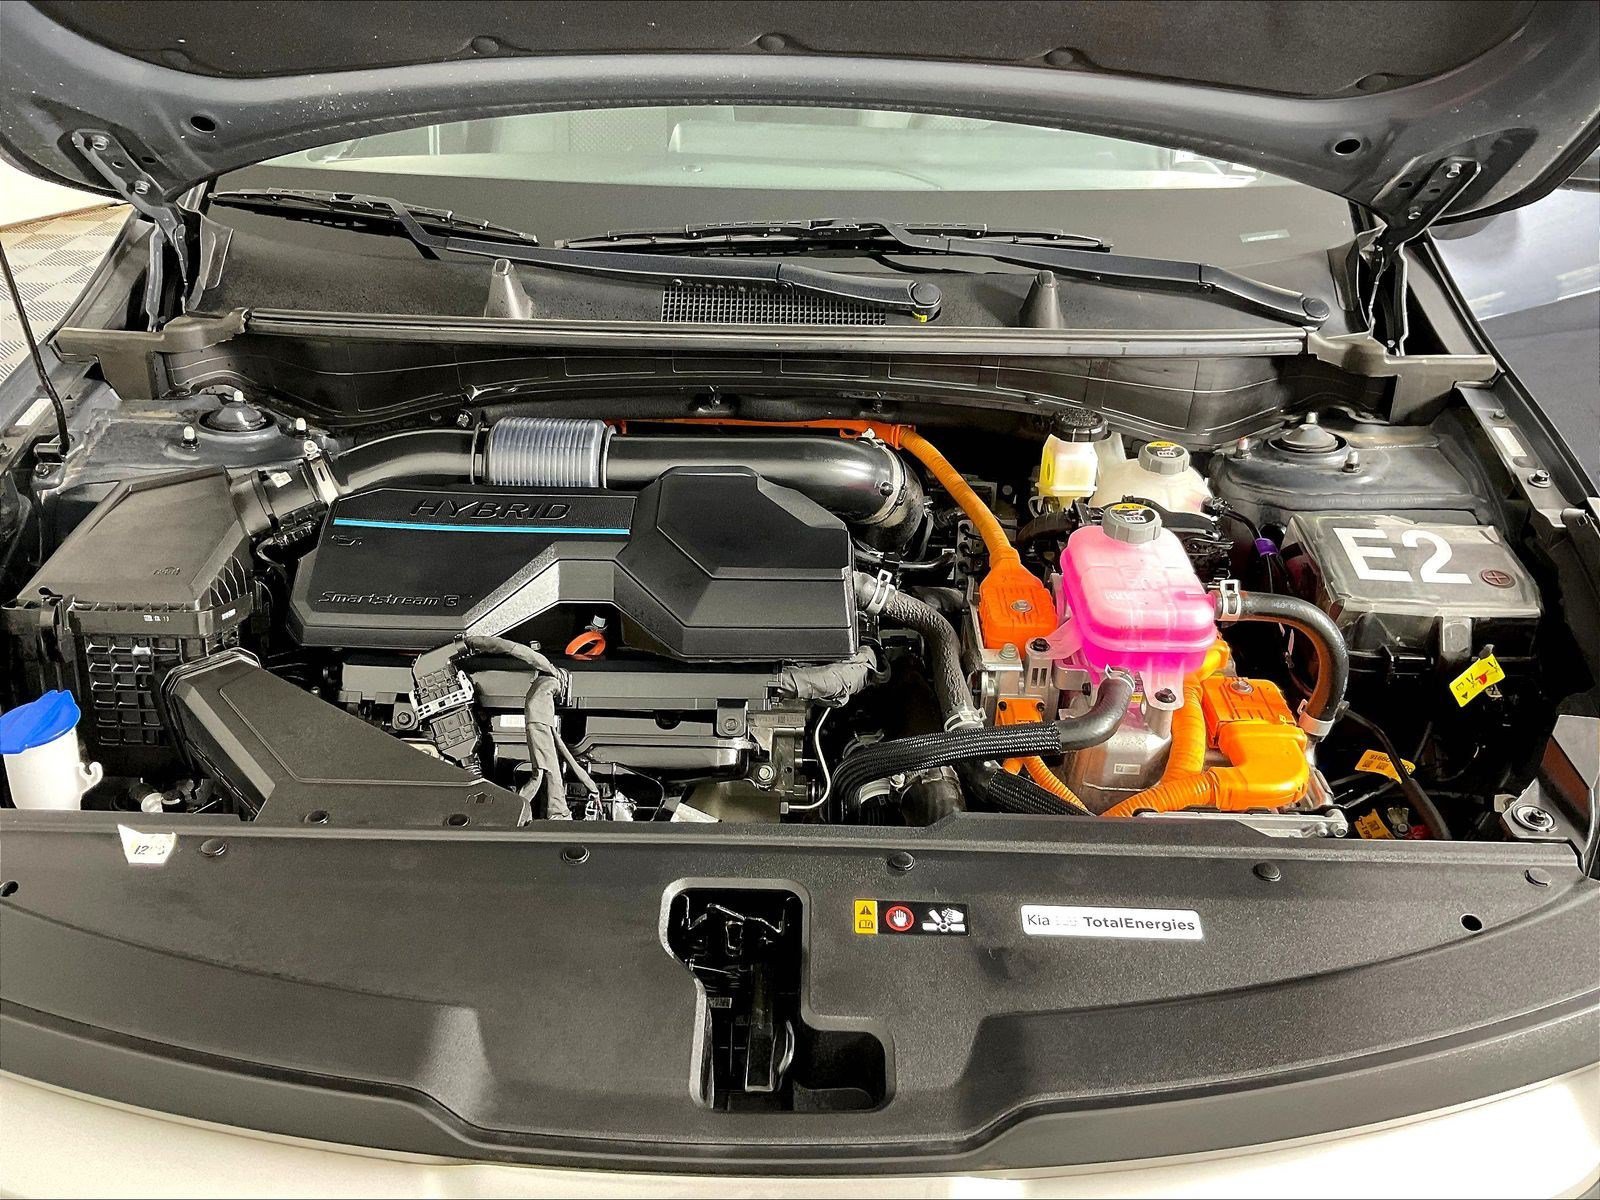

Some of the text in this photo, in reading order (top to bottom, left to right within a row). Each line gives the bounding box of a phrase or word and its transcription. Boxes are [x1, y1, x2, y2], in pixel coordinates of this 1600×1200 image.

[409, 499, 572, 521] HYBRID
[1332, 526, 1473, 585] E2
[318, 590, 441, 607] Smartstream
[1027, 914, 1051, 927] Kia
[1083, 915, 1196, 933] TotalEnergies
